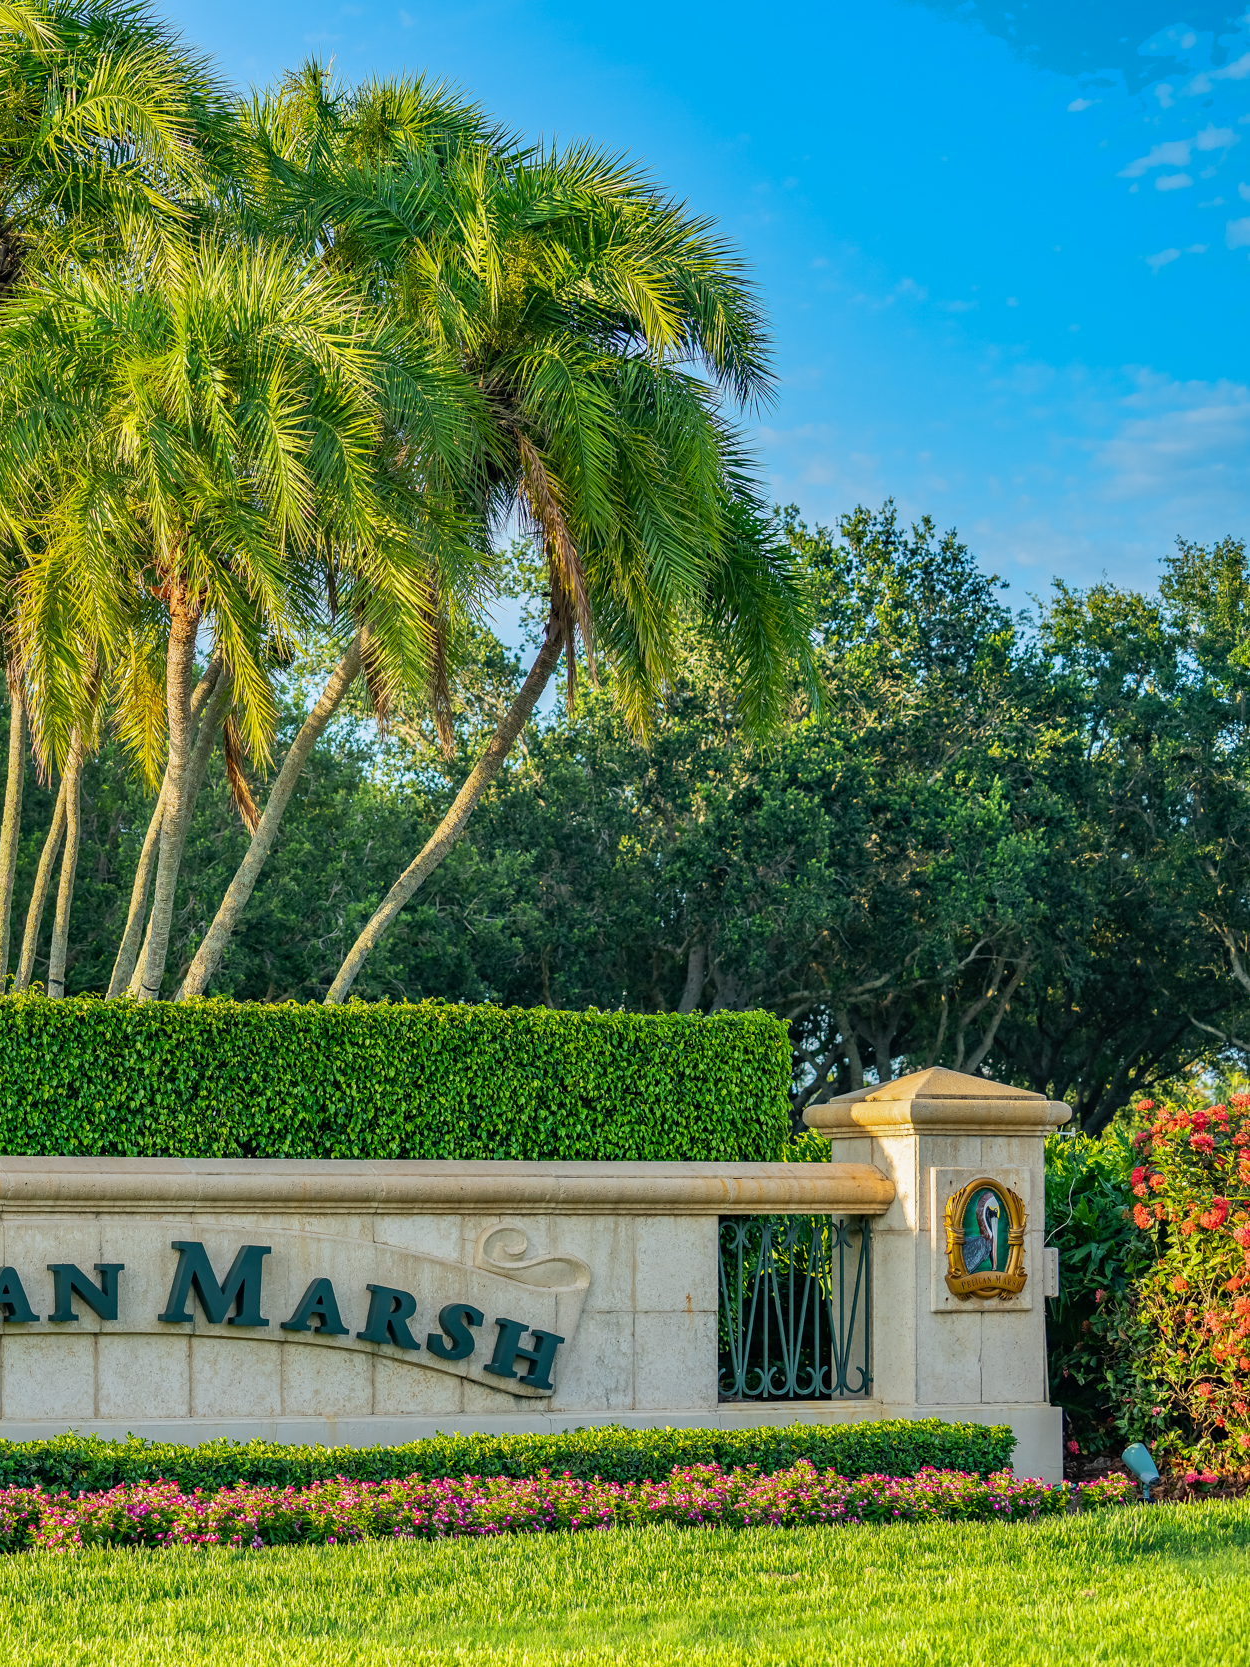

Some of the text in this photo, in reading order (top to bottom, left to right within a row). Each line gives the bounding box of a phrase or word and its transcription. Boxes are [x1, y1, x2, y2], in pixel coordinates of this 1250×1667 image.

[158, 1241, 565, 1390] MARSH
[961, 1275, 1023, 1290] PELICAN MARSH
